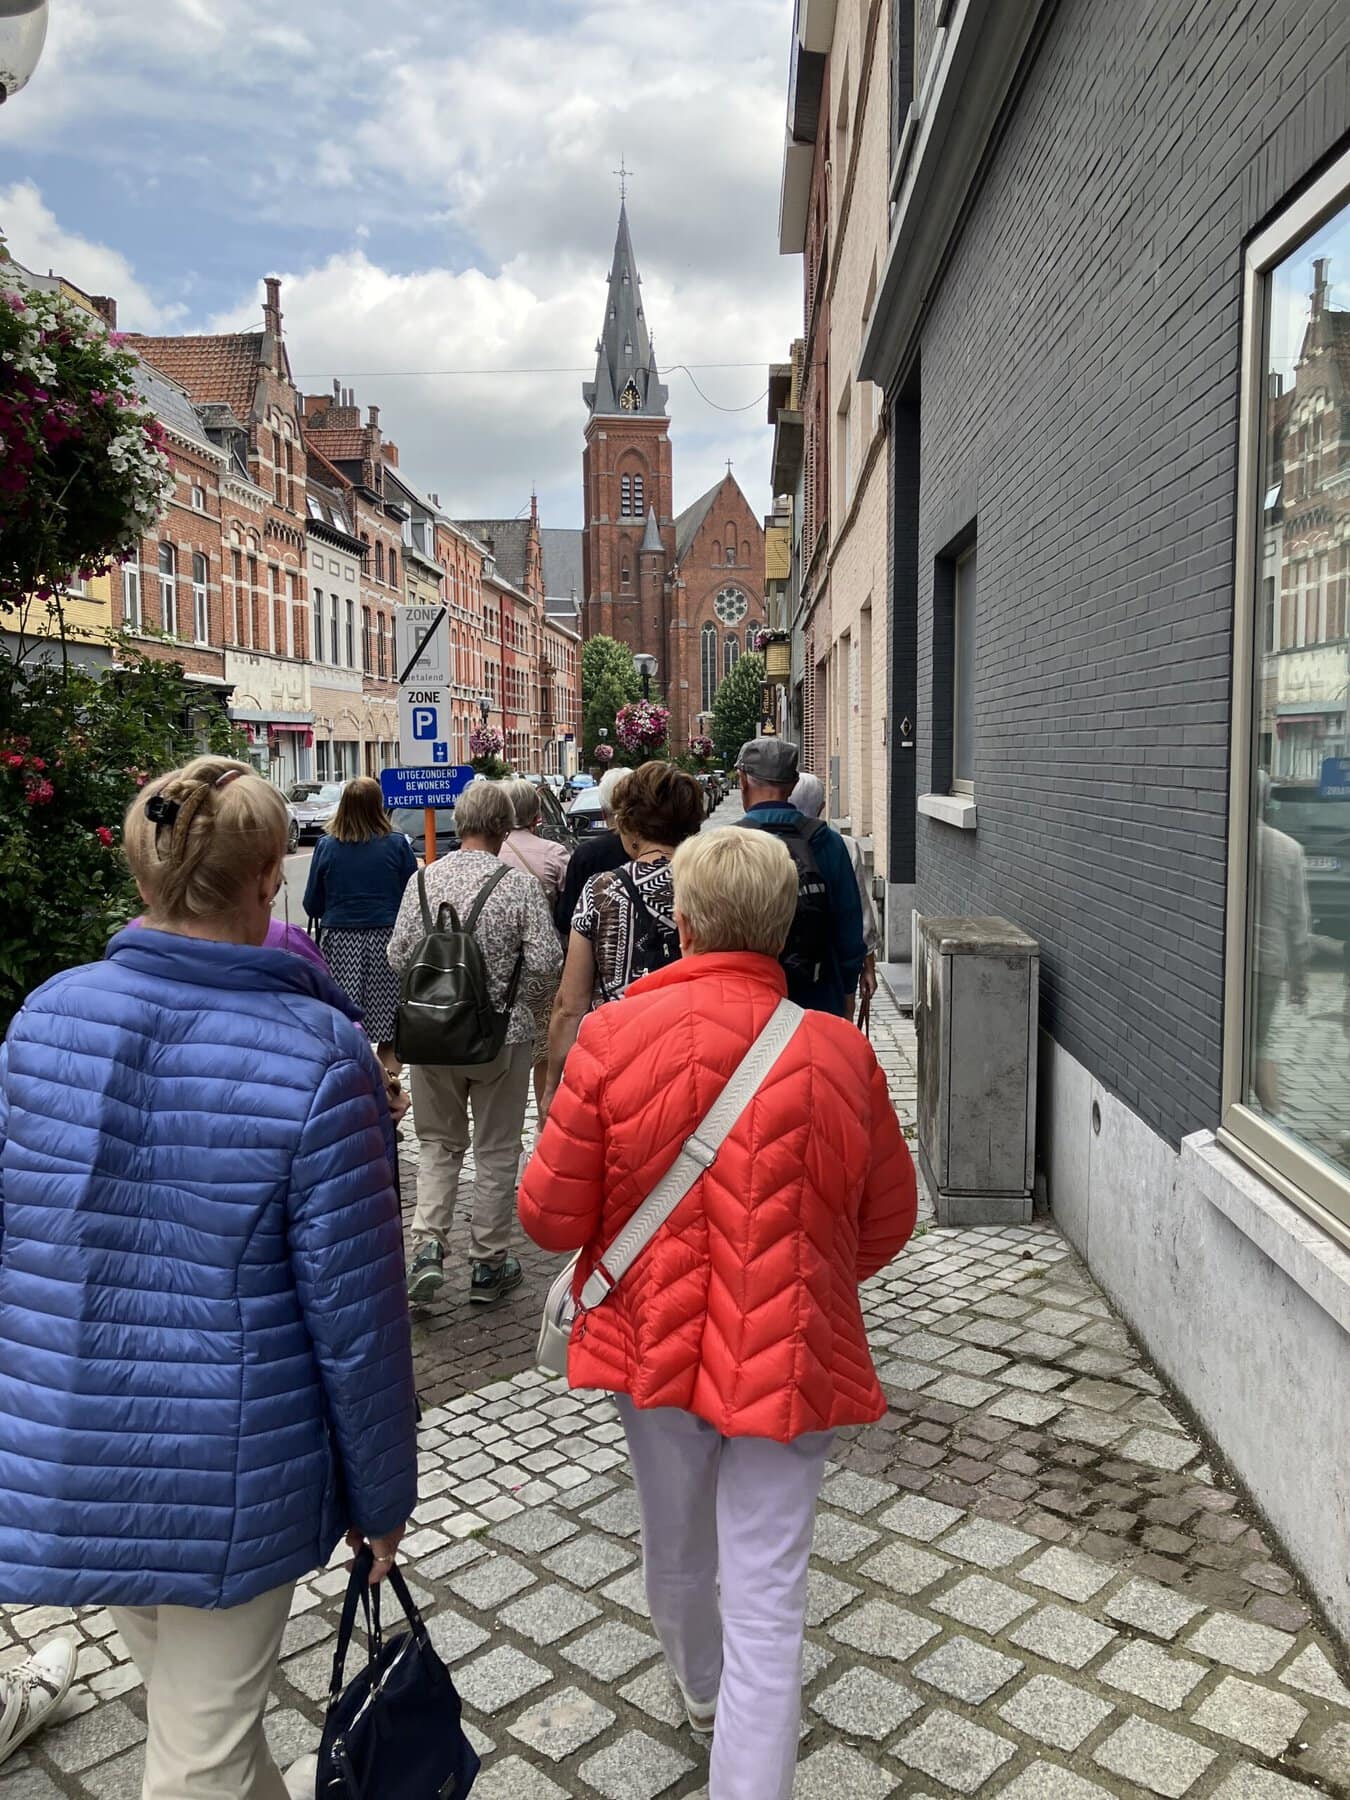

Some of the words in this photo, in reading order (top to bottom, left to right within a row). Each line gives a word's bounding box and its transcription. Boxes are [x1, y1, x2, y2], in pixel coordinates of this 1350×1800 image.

[405, 608, 438, 621] ZONE
[408, 691, 441, 703] ZONE
[416, 711, 433, 736] P
[397, 768, 458, 780] UITGEZONDERD
[406, 780, 450, 791] BEWONERS
[388, 794, 424, 806] EXCEPTE
